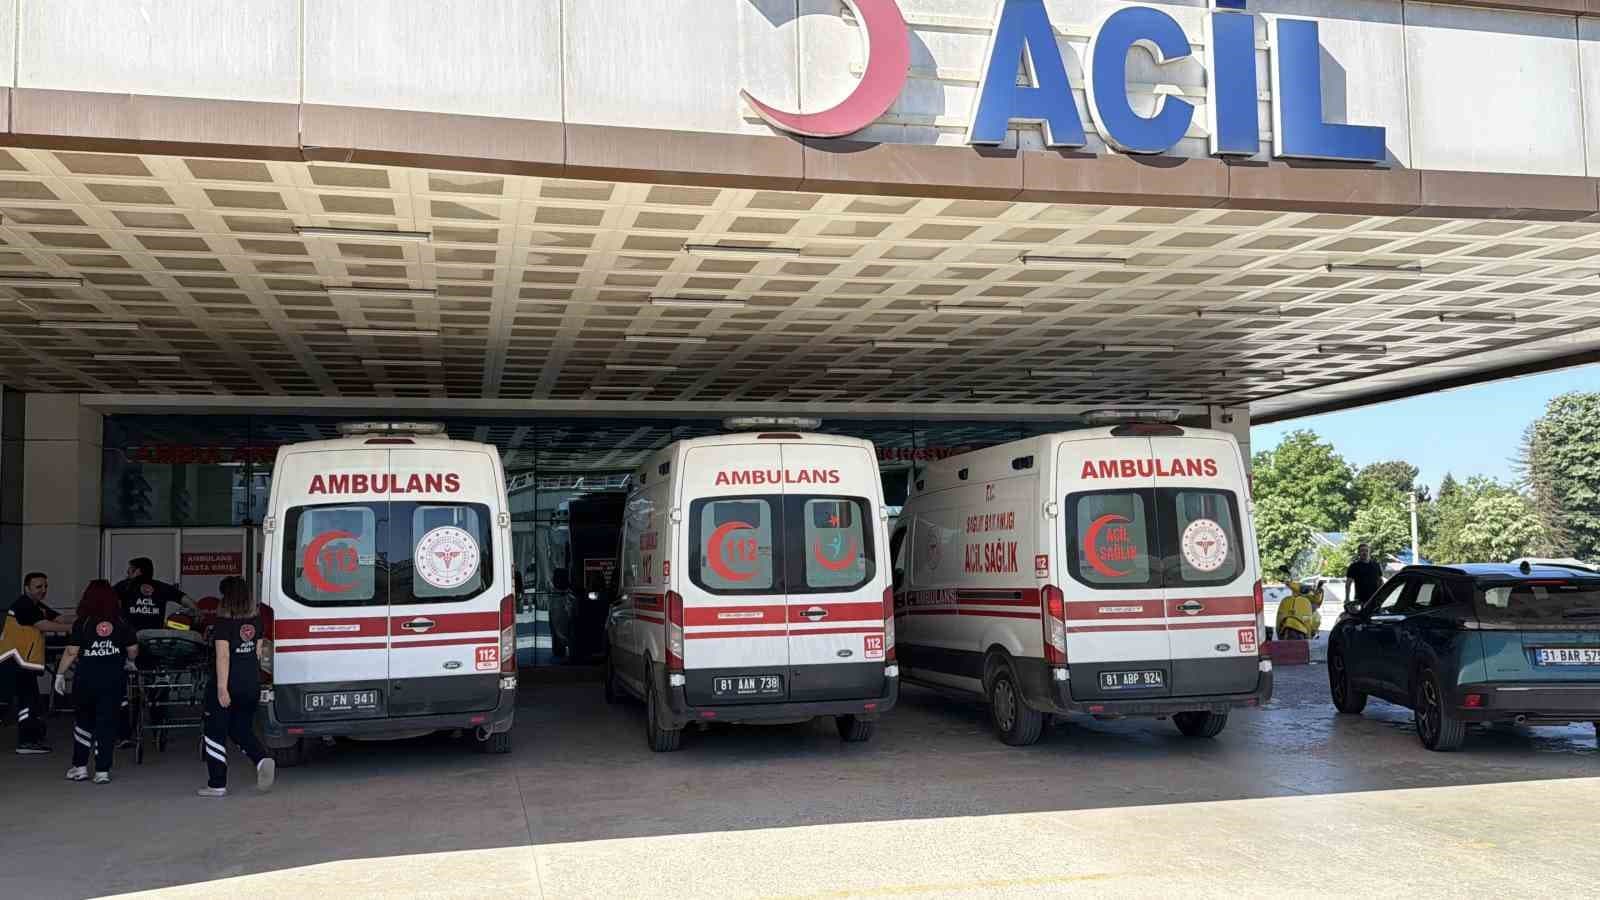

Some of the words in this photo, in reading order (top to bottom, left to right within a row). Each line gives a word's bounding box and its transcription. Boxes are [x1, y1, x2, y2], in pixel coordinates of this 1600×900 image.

[966, 0, 1386, 162] ACİL
[1081, 458, 1218, 480] AMBULANS
[308, 473, 460, 495] AMBULANS
[715, 469, 841, 486] AMBULANS
[727, 538, 758, 561] 112
[984, 539, 1018, 573] SAĞLIK
[322, 547, 358, 573] 112
[866, 638, 882, 649] 112
[1239, 631, 1255, 644] 112
[478, 649, 496, 661] 112
[1542, 650, 1556, 661] 31
[1560, 650, 1581, 661] BAR
[720, 679, 732, 690] 81
[738, 678, 755, 690] AAN
[1106, 675, 1118, 686] 81
[1123, 673, 1139, 685] ABP
[1144, 672, 1161, 684] 924
[312, 695, 324, 707] 81
[332, 694, 347, 706] FN
[354, 693, 374, 705] 941
